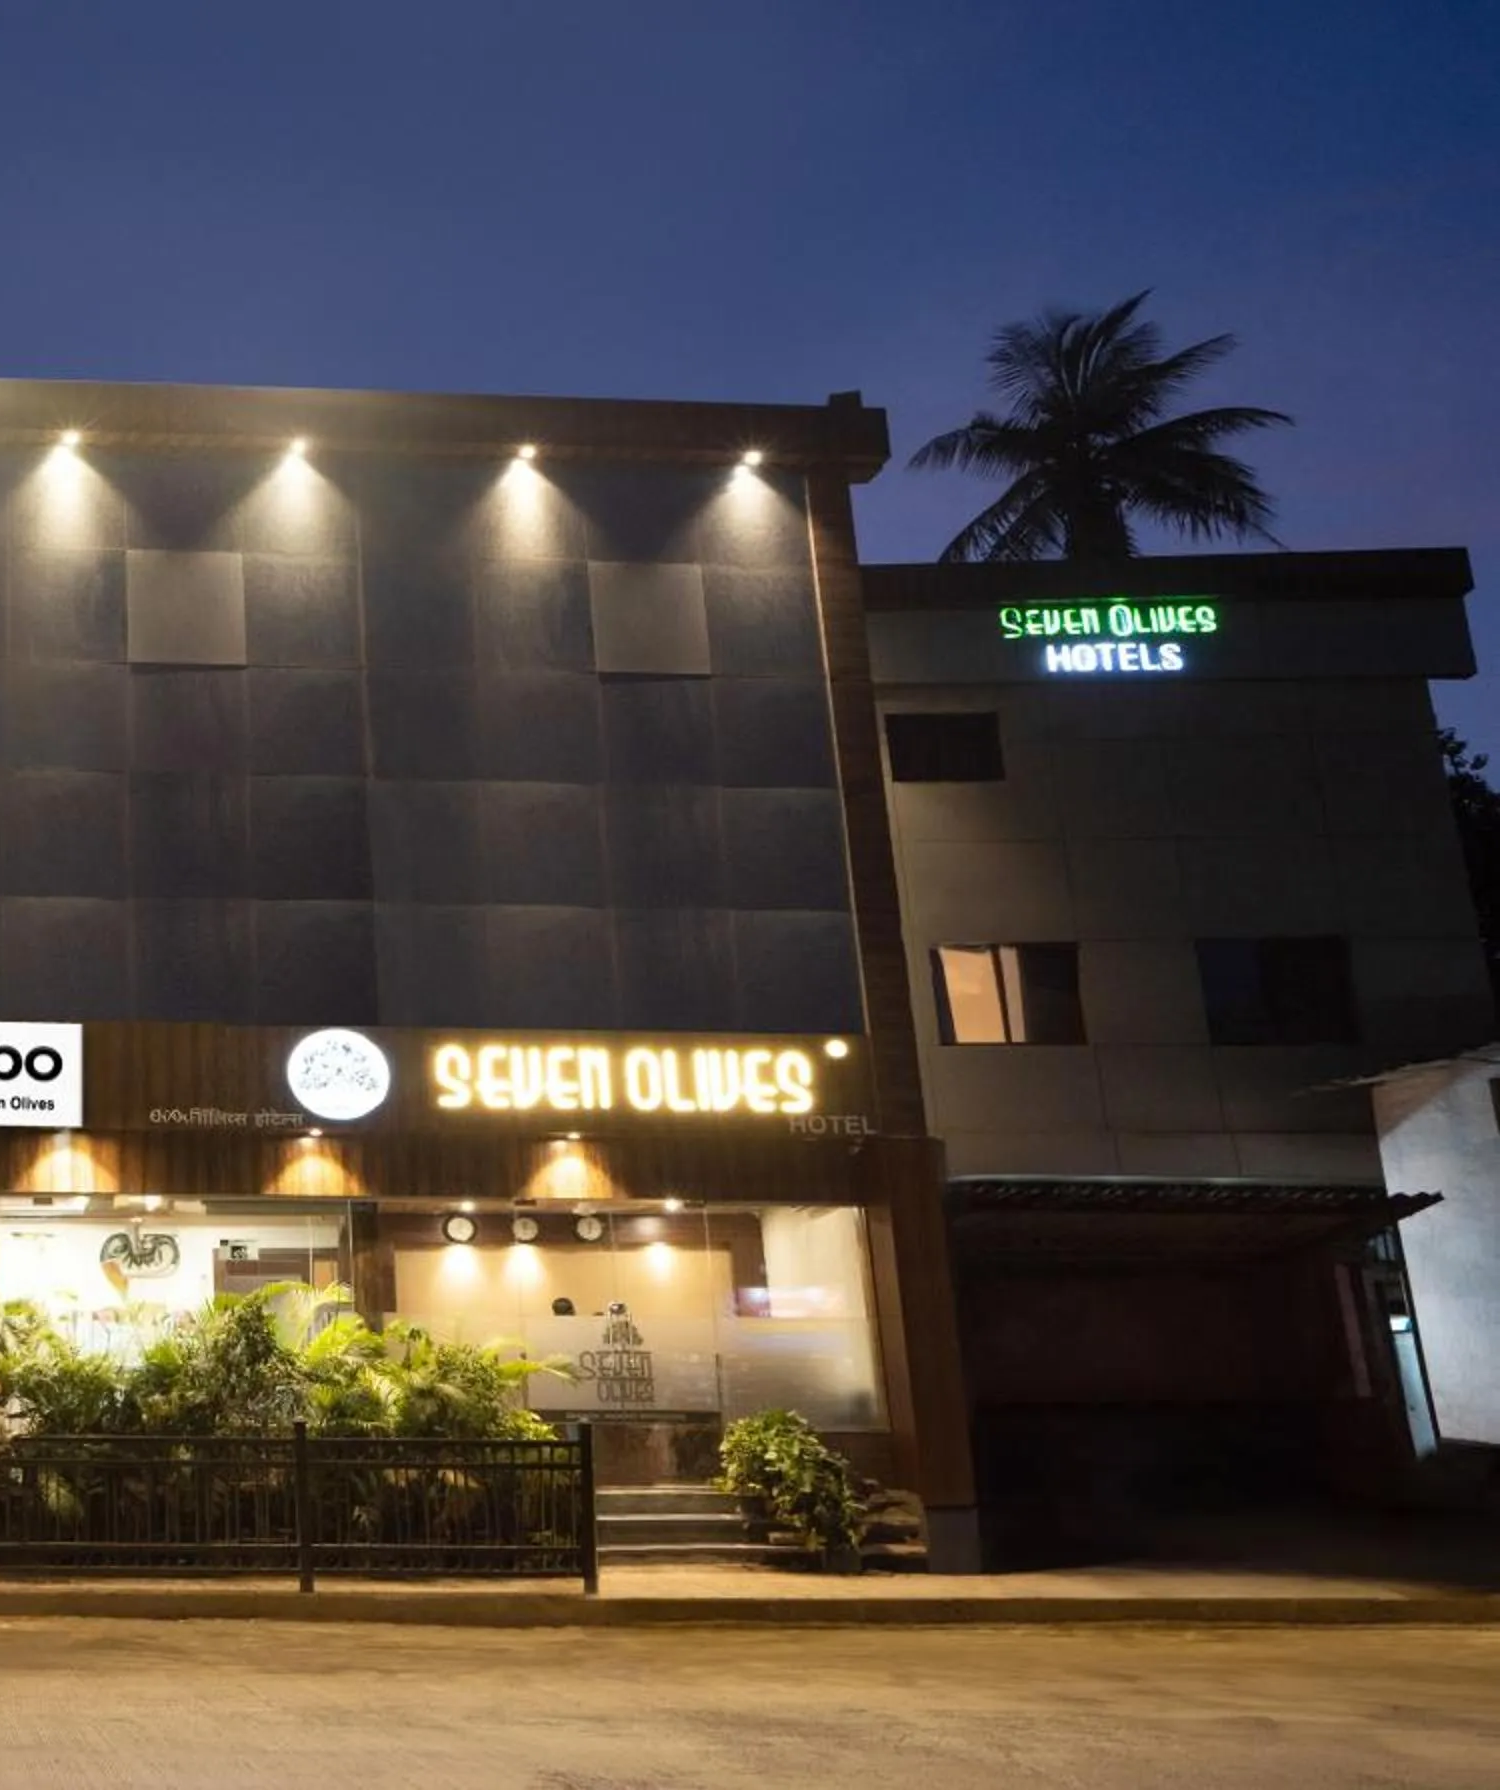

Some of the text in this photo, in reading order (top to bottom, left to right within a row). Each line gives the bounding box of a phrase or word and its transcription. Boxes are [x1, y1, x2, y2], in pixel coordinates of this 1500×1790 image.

[1046, 643, 1184, 672] HOTELS
[435, 1043, 814, 1113] SEVEN OLIVES
[10, 1096, 55, 1110] Olives
[789, 1114, 877, 1135] HOTEL
